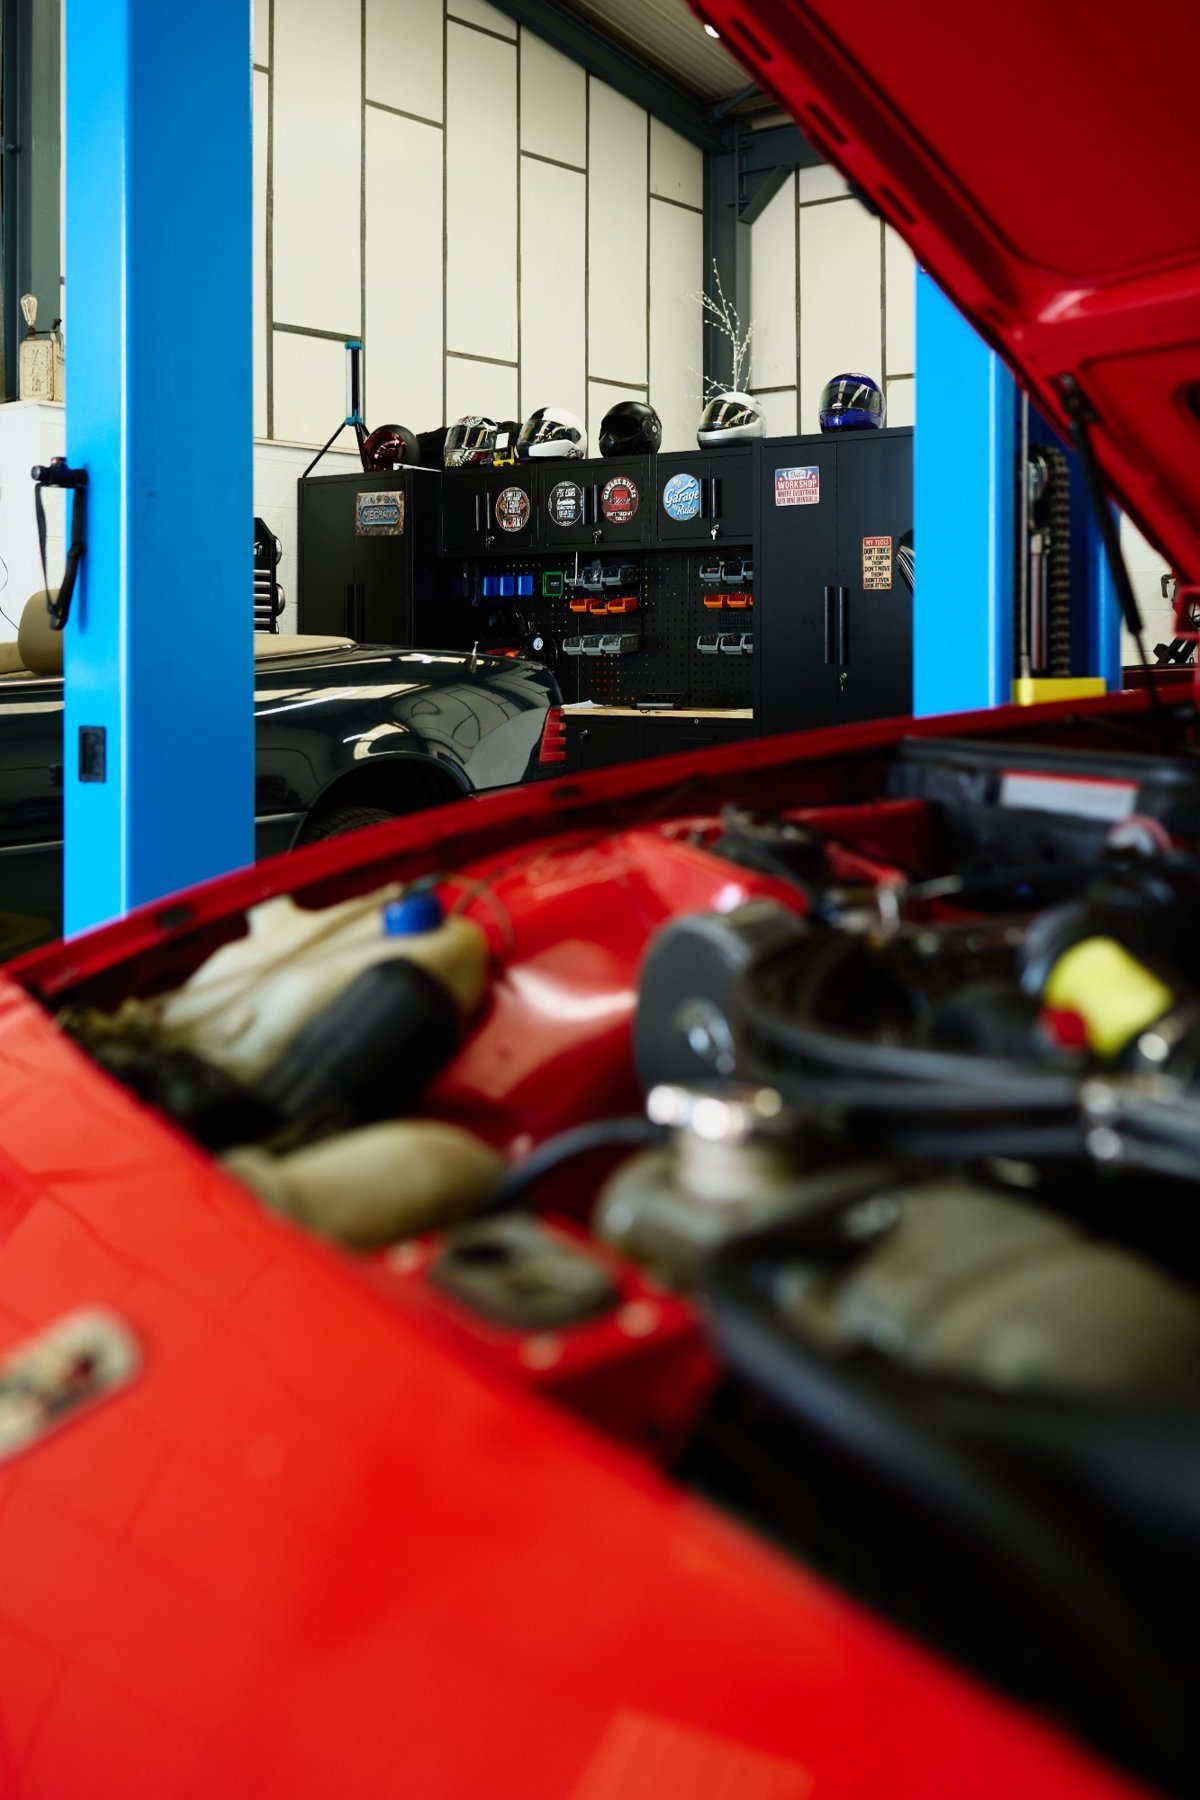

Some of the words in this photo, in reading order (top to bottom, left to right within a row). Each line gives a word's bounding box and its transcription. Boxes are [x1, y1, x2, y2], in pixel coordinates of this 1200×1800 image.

[604, 478, 622, 499] GARAGE
[622, 479, 636, 499] RULES
[778, 479, 817, 490] WORKSHOP
[665, 489, 700, 507] Garage
[777, 490, 792, 498] WHERE
[363, 510, 398, 520] MECHANIC
